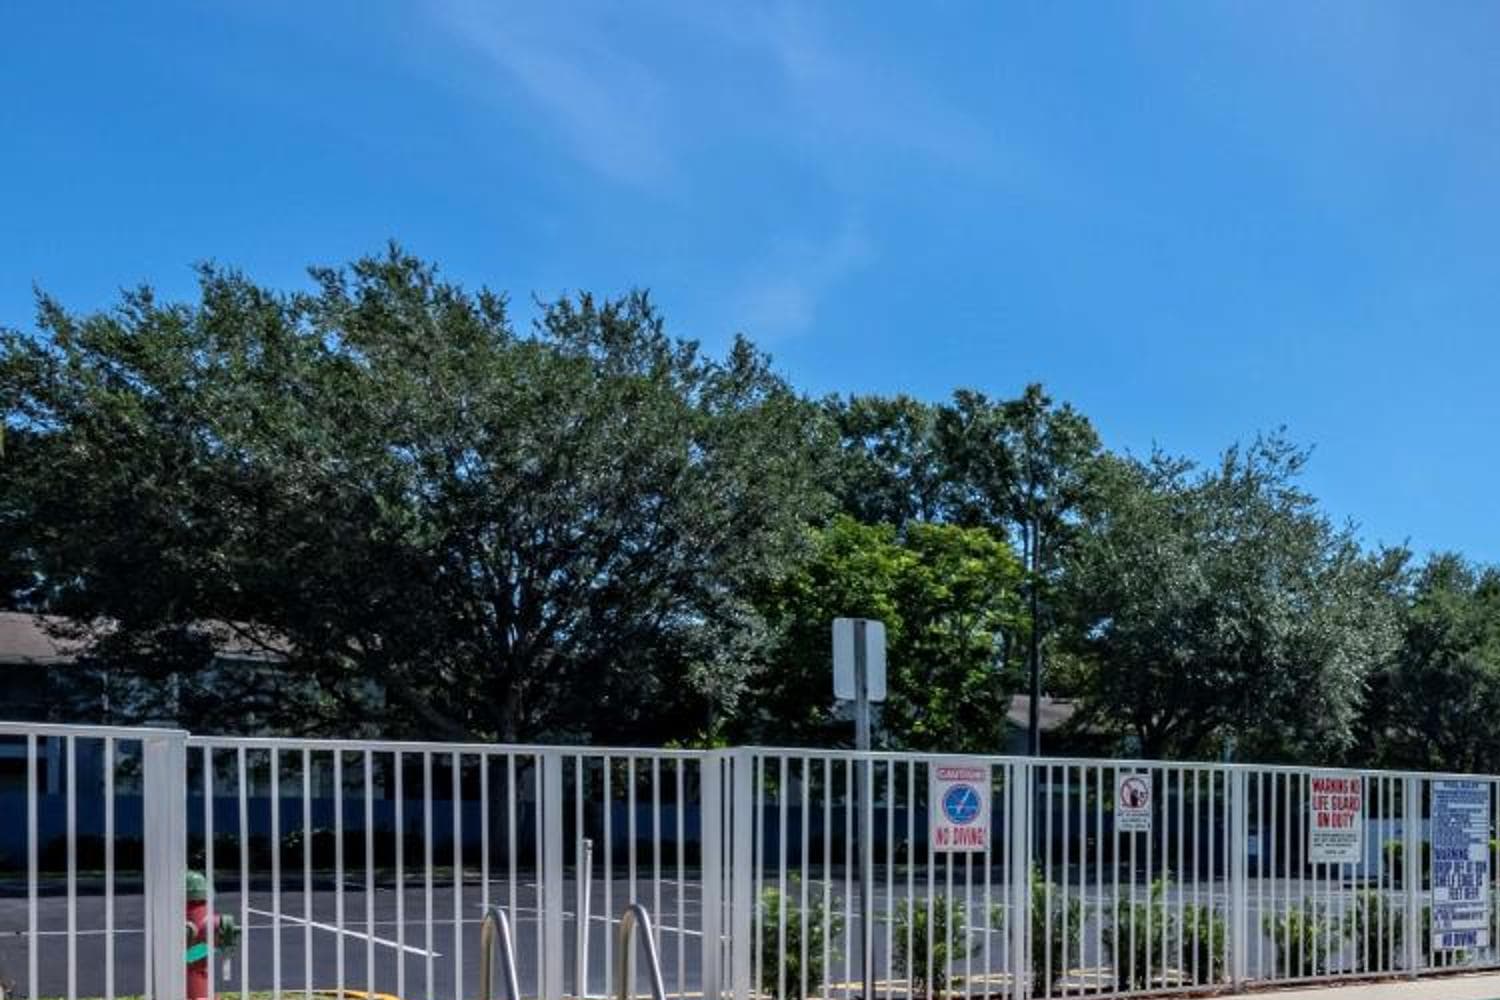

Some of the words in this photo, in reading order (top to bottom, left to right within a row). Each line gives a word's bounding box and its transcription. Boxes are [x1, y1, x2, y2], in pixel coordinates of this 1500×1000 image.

[1312, 778, 1348, 793] WARNING
[1312, 795, 1329, 810] LIFE
[1331, 796, 1360, 811] GUARD
[1317, 812, 1329, 827] ON
[1331, 813, 1354, 828] DUTY
[935, 827, 950, 846] NO
[1442, 933, 1452, 947] NO
[1453, 930, 1477, 946] DIVING
